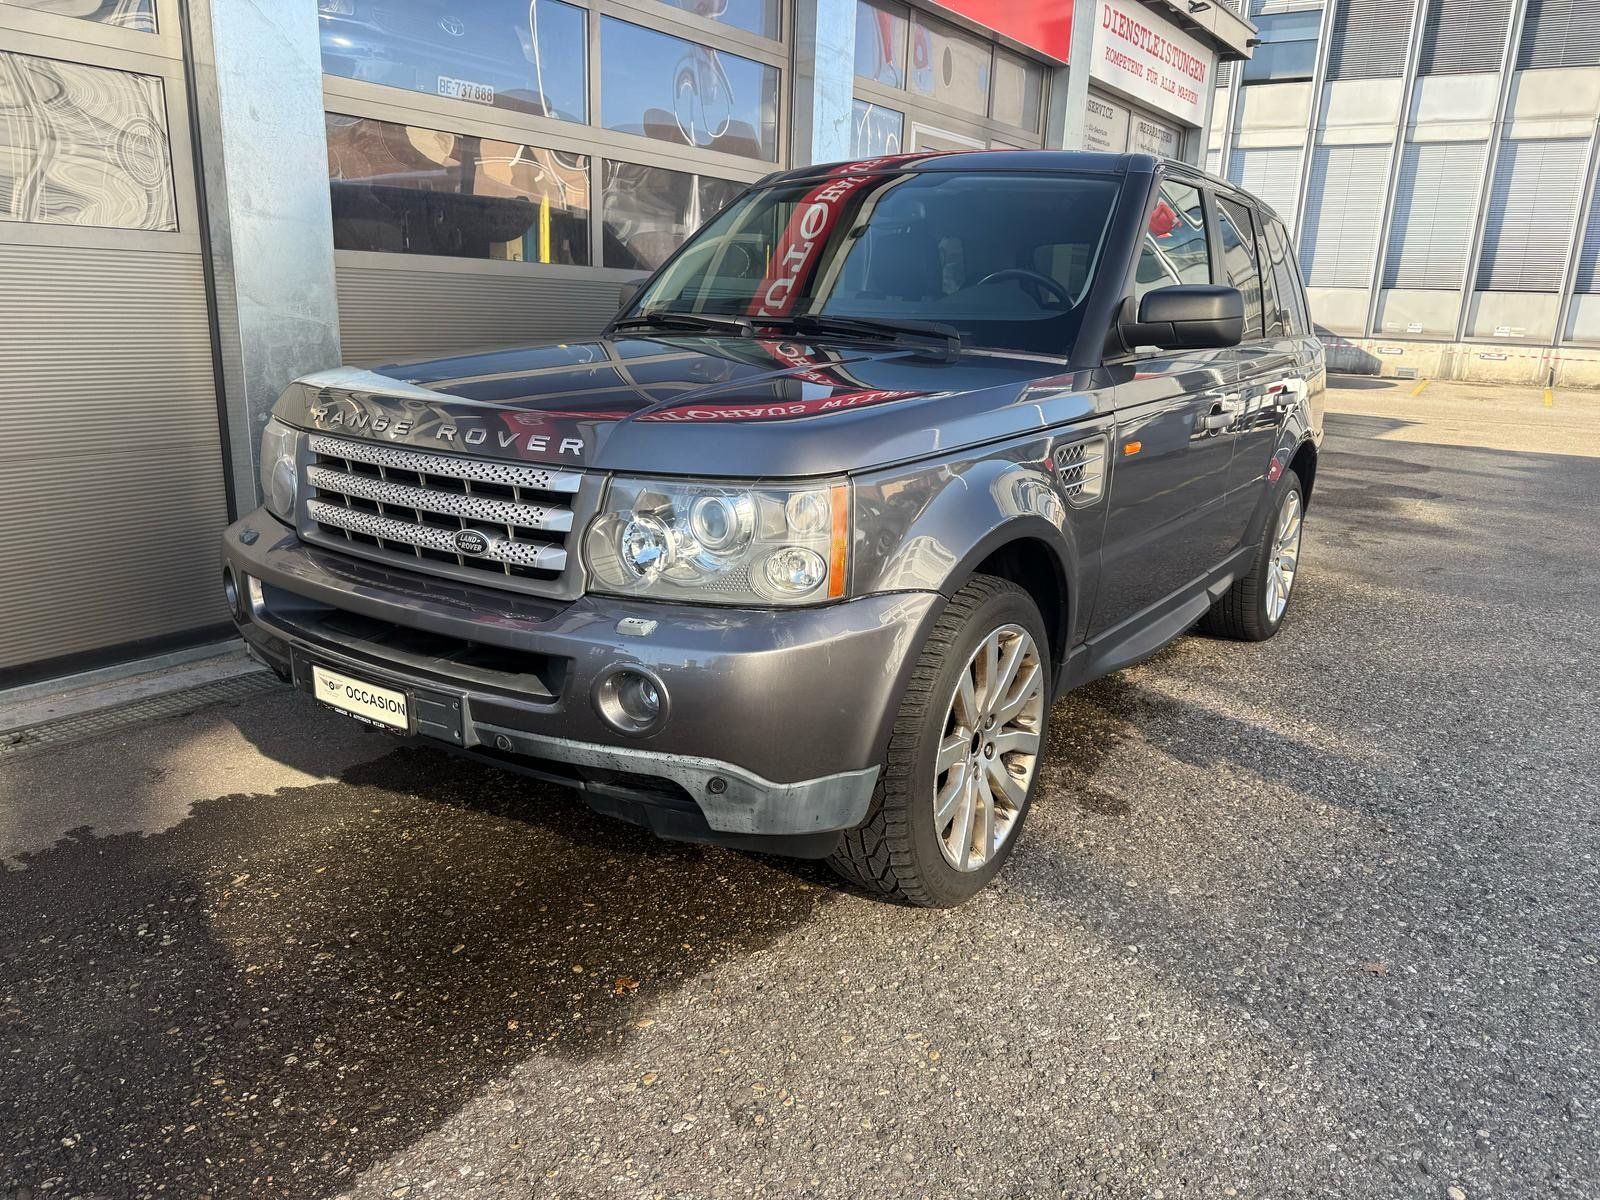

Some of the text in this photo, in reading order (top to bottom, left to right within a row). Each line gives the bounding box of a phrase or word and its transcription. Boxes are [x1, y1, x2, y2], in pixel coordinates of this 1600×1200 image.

[1102, 4, 1206, 83] DIENSTLEISTUNGEN
[1105, 46, 1199, 105] KOMPETENZ FÜR ALLE MARKEN
[1087, 100, 1114, 120] SERVICE
[313, 407, 585, 456] RANGE ROVER
[346, 686, 406, 716] OCCASION
